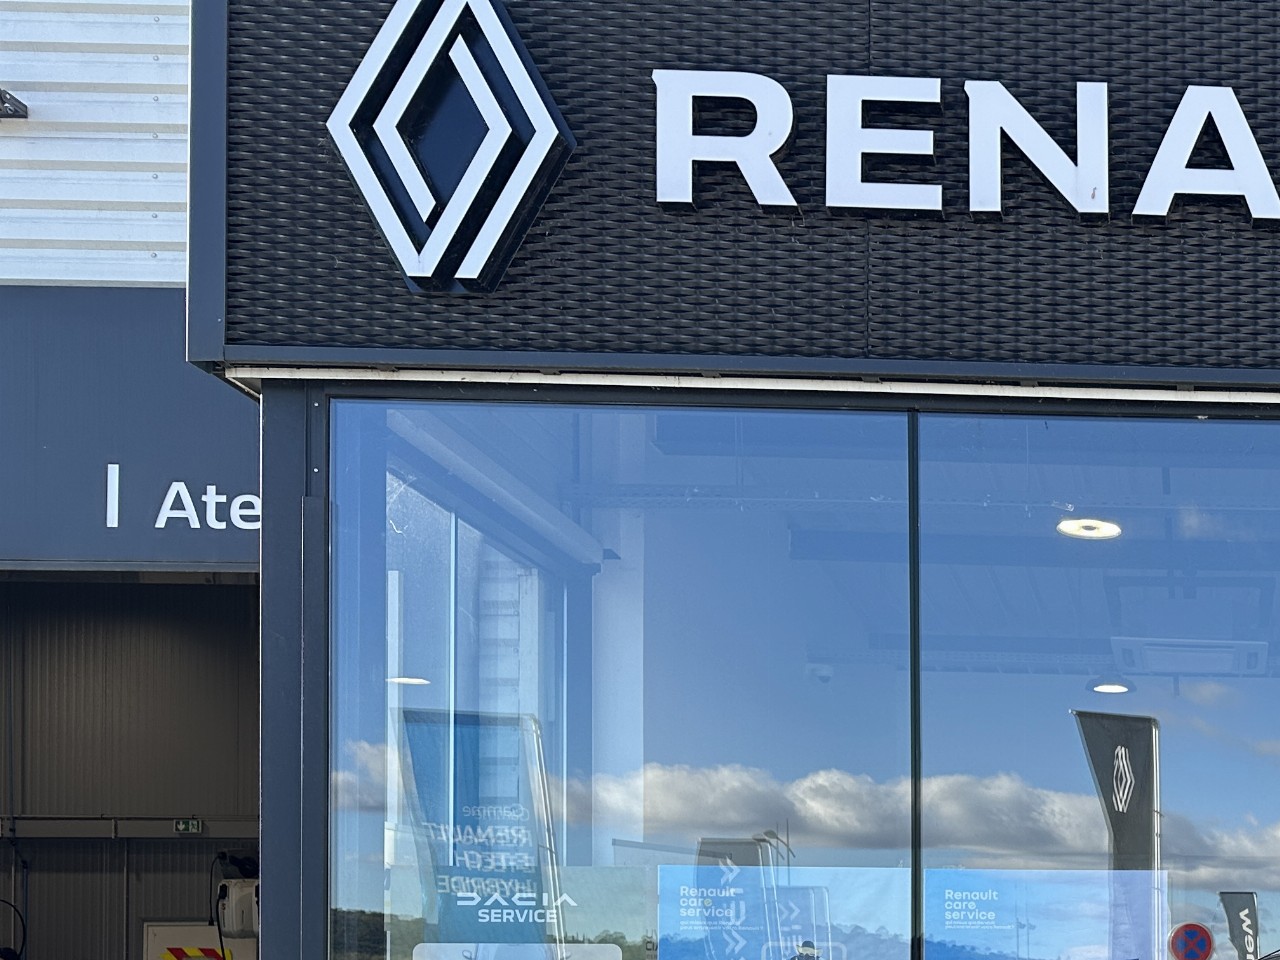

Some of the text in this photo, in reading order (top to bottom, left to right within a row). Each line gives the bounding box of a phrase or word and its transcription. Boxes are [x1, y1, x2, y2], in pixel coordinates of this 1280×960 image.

[155, 481, 260, 530] Ate
[680, 886, 736, 897] Renault
[945, 889, 999, 901] Renault
[457, 893, 578, 906] DACIA
[680, 898, 713, 907] care
[945, 901, 976, 910] care
[478, 909, 557, 923] SERVICE
[680, 906, 734, 917] service
[945, 909, 996, 920] service
